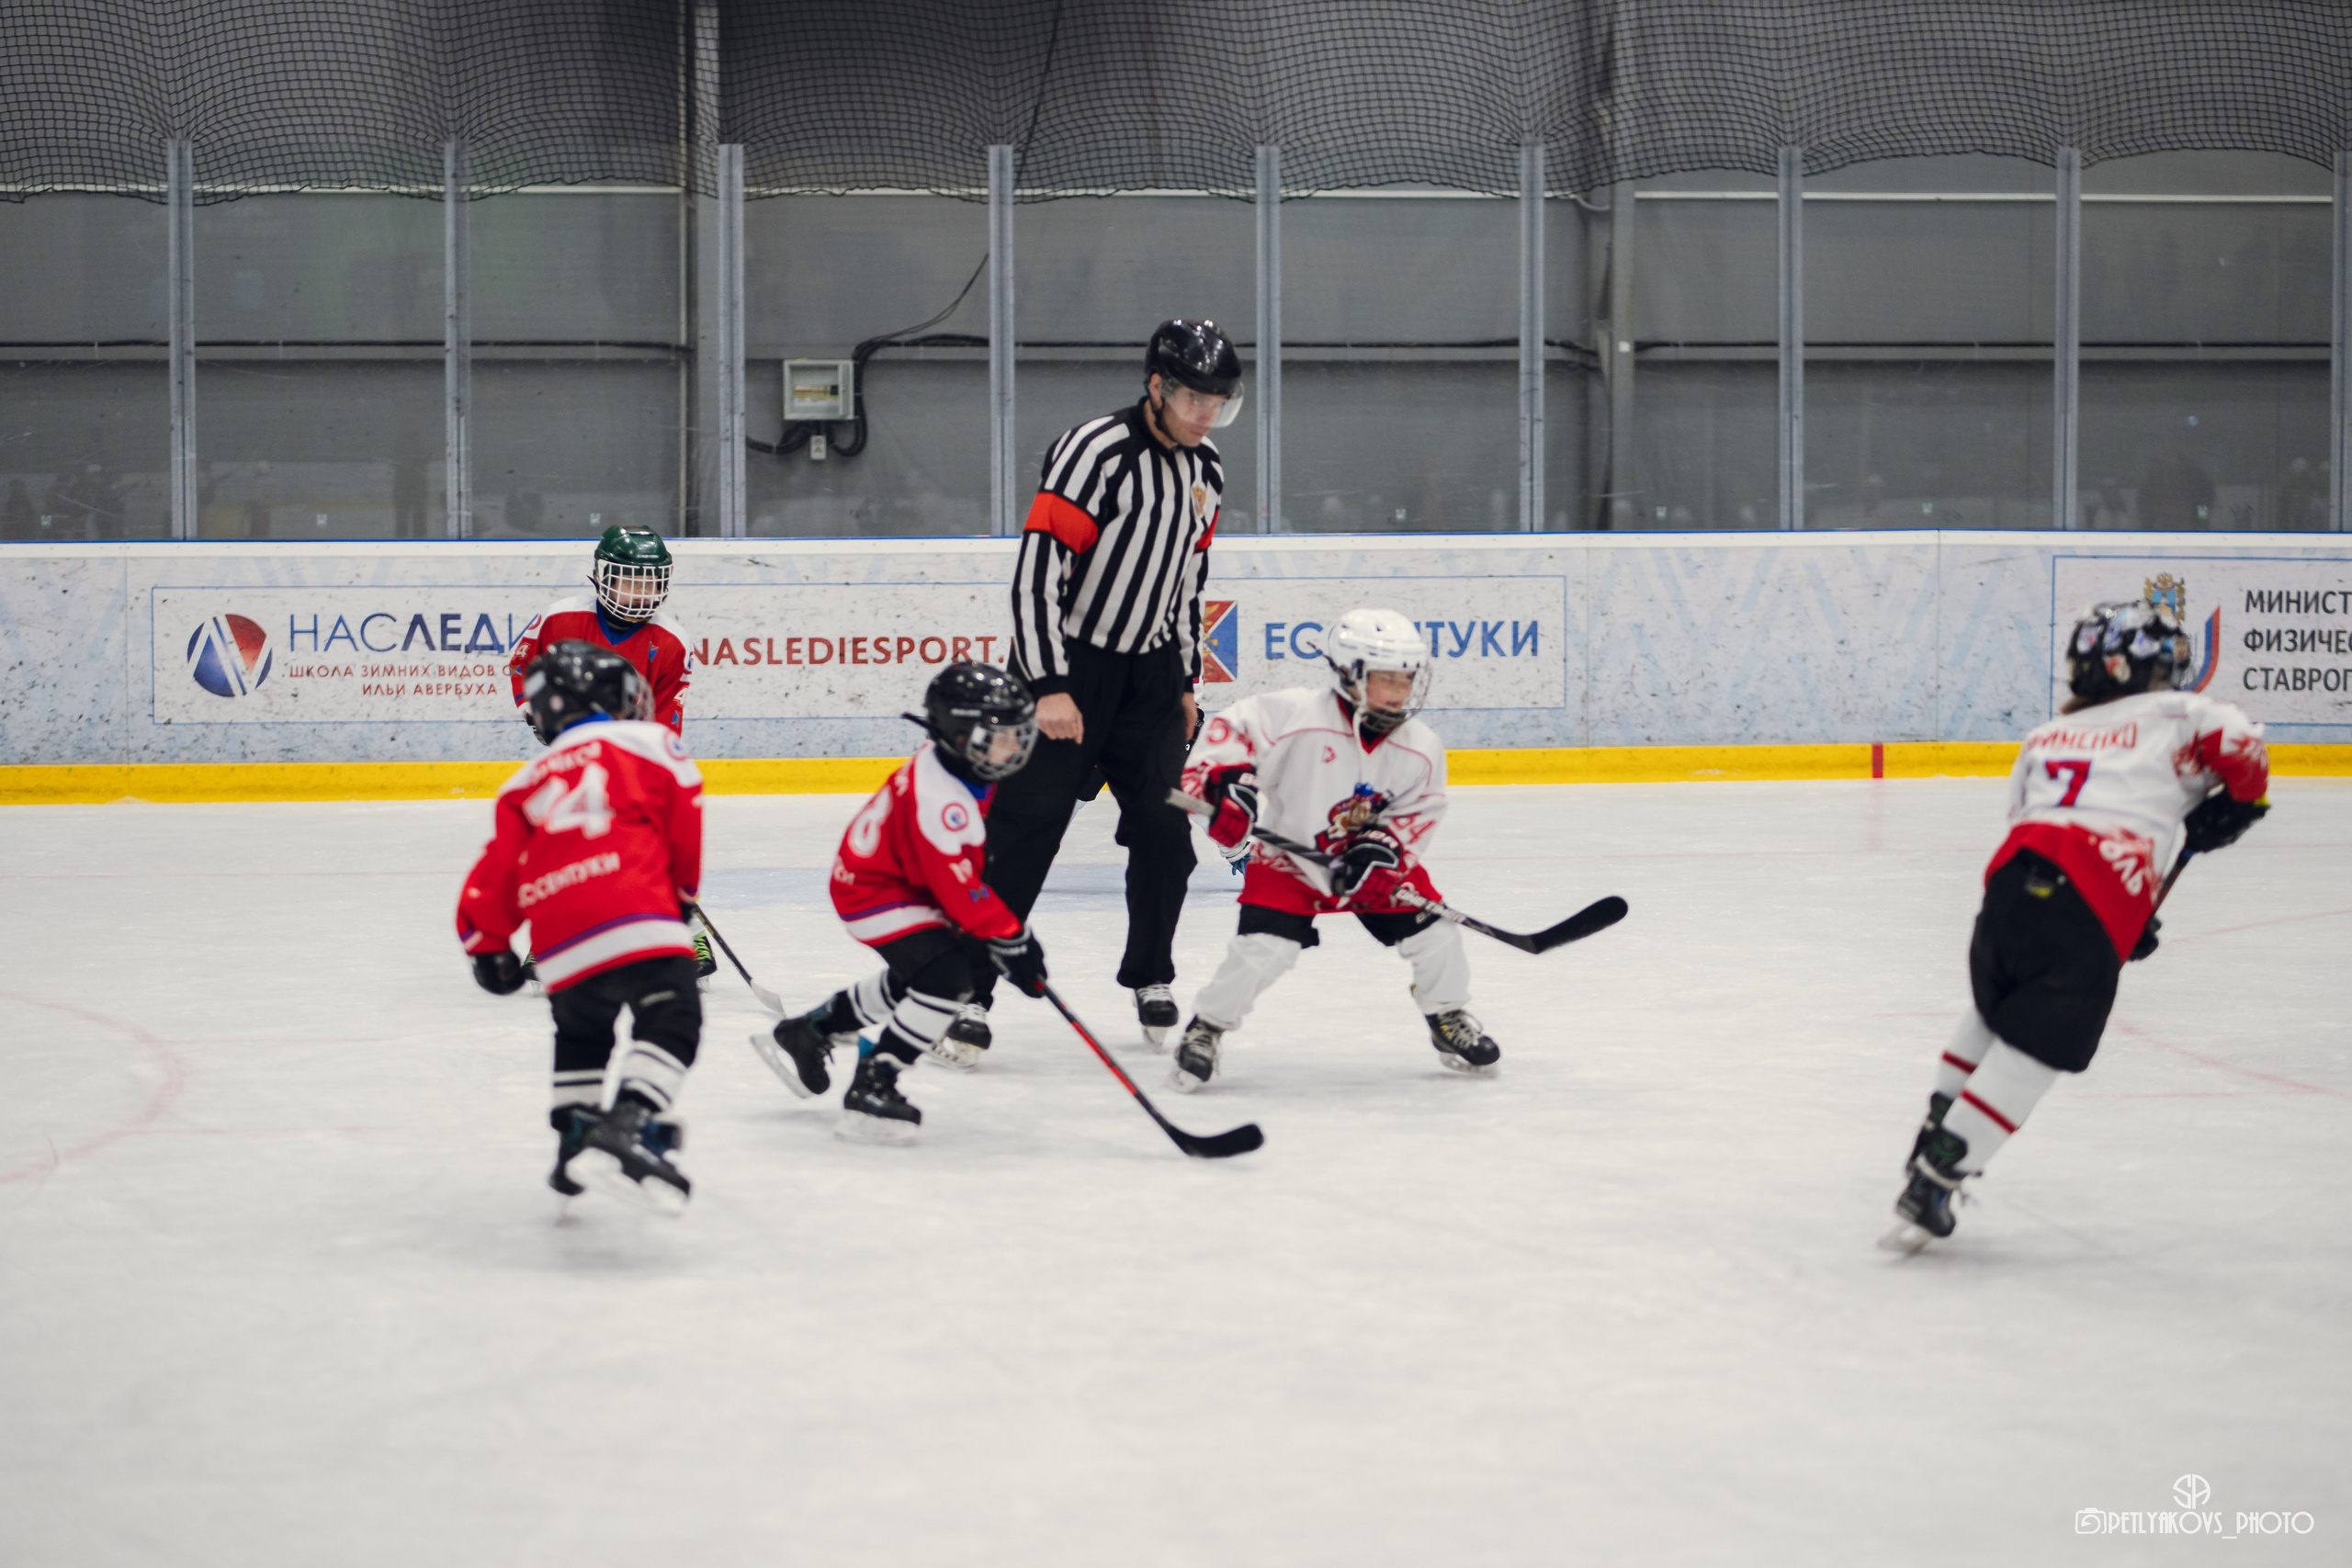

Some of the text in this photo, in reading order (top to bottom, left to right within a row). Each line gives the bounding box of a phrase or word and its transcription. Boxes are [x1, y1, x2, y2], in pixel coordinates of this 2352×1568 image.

[289, 612, 540, 654] НАСЛЕДИ
[1264, 620, 1539, 660] ЕСТУКИ
[2244, 627, 2352, 653] ФИЗИЧЕ
[693, 635, 1014, 666] NASLEDIESPORT.
[289, 664, 354, 678] ШКОЛА
[361, 664, 431, 678] ЗИМНИХ
[437, 663, 495, 678] ВИДОВ
[362, 682, 498, 696] ИЛЬИ АВЕРБУХА
[2042, 758, 2093, 808] 7
